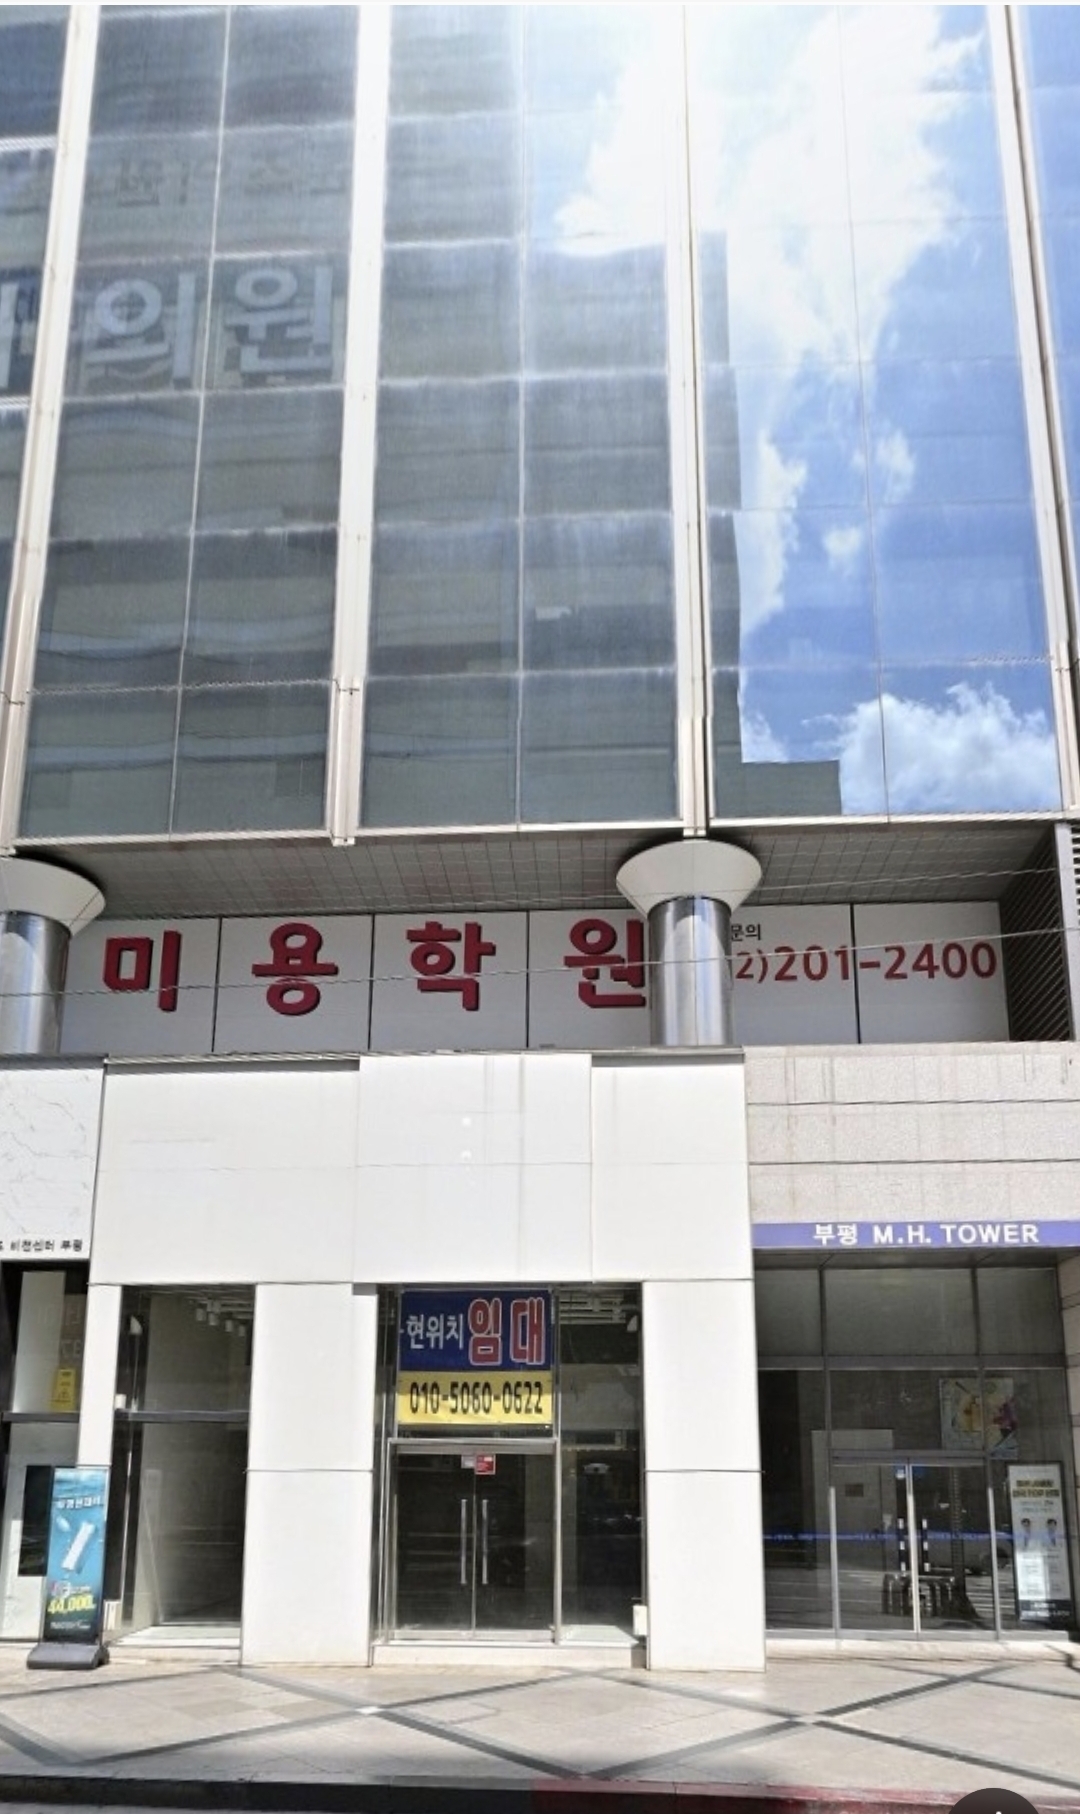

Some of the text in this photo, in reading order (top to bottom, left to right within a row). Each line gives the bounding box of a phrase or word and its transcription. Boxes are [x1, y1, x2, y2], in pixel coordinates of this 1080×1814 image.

[731, 923, 762, 942] 문의
[103, 918, 647, 1016] 미용학원
[813, 1223, 1039, 1246] 부평 M.H. TOWER
[406, 1297, 545, 1366] 현위치 임대
[405, 1381, 543, 1414] 010-5060-0622
